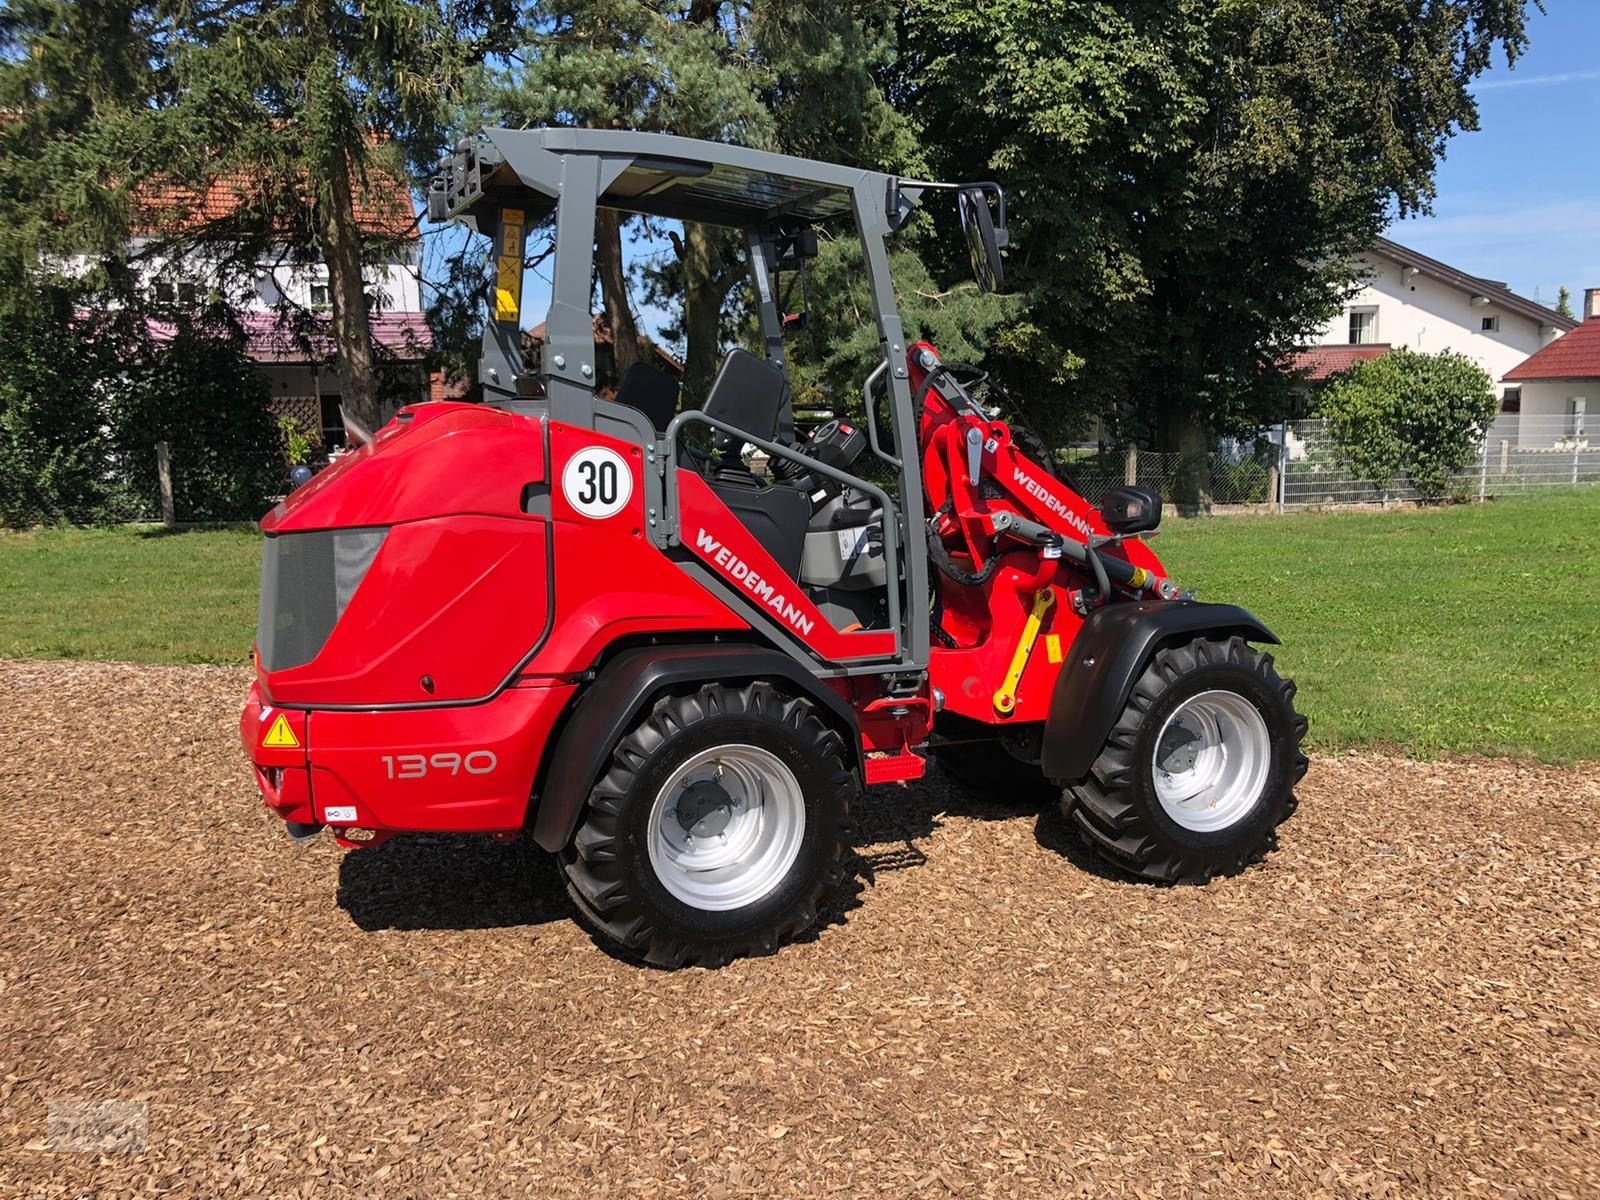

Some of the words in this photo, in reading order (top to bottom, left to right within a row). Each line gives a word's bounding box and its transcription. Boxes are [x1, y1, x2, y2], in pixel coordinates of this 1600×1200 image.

[578, 461, 617, 505] 30
[1013, 467, 1095, 535] WEIDEMANN
[696, 528, 814, 636] WEIDEMANN
[382, 750, 497, 779] 1390
